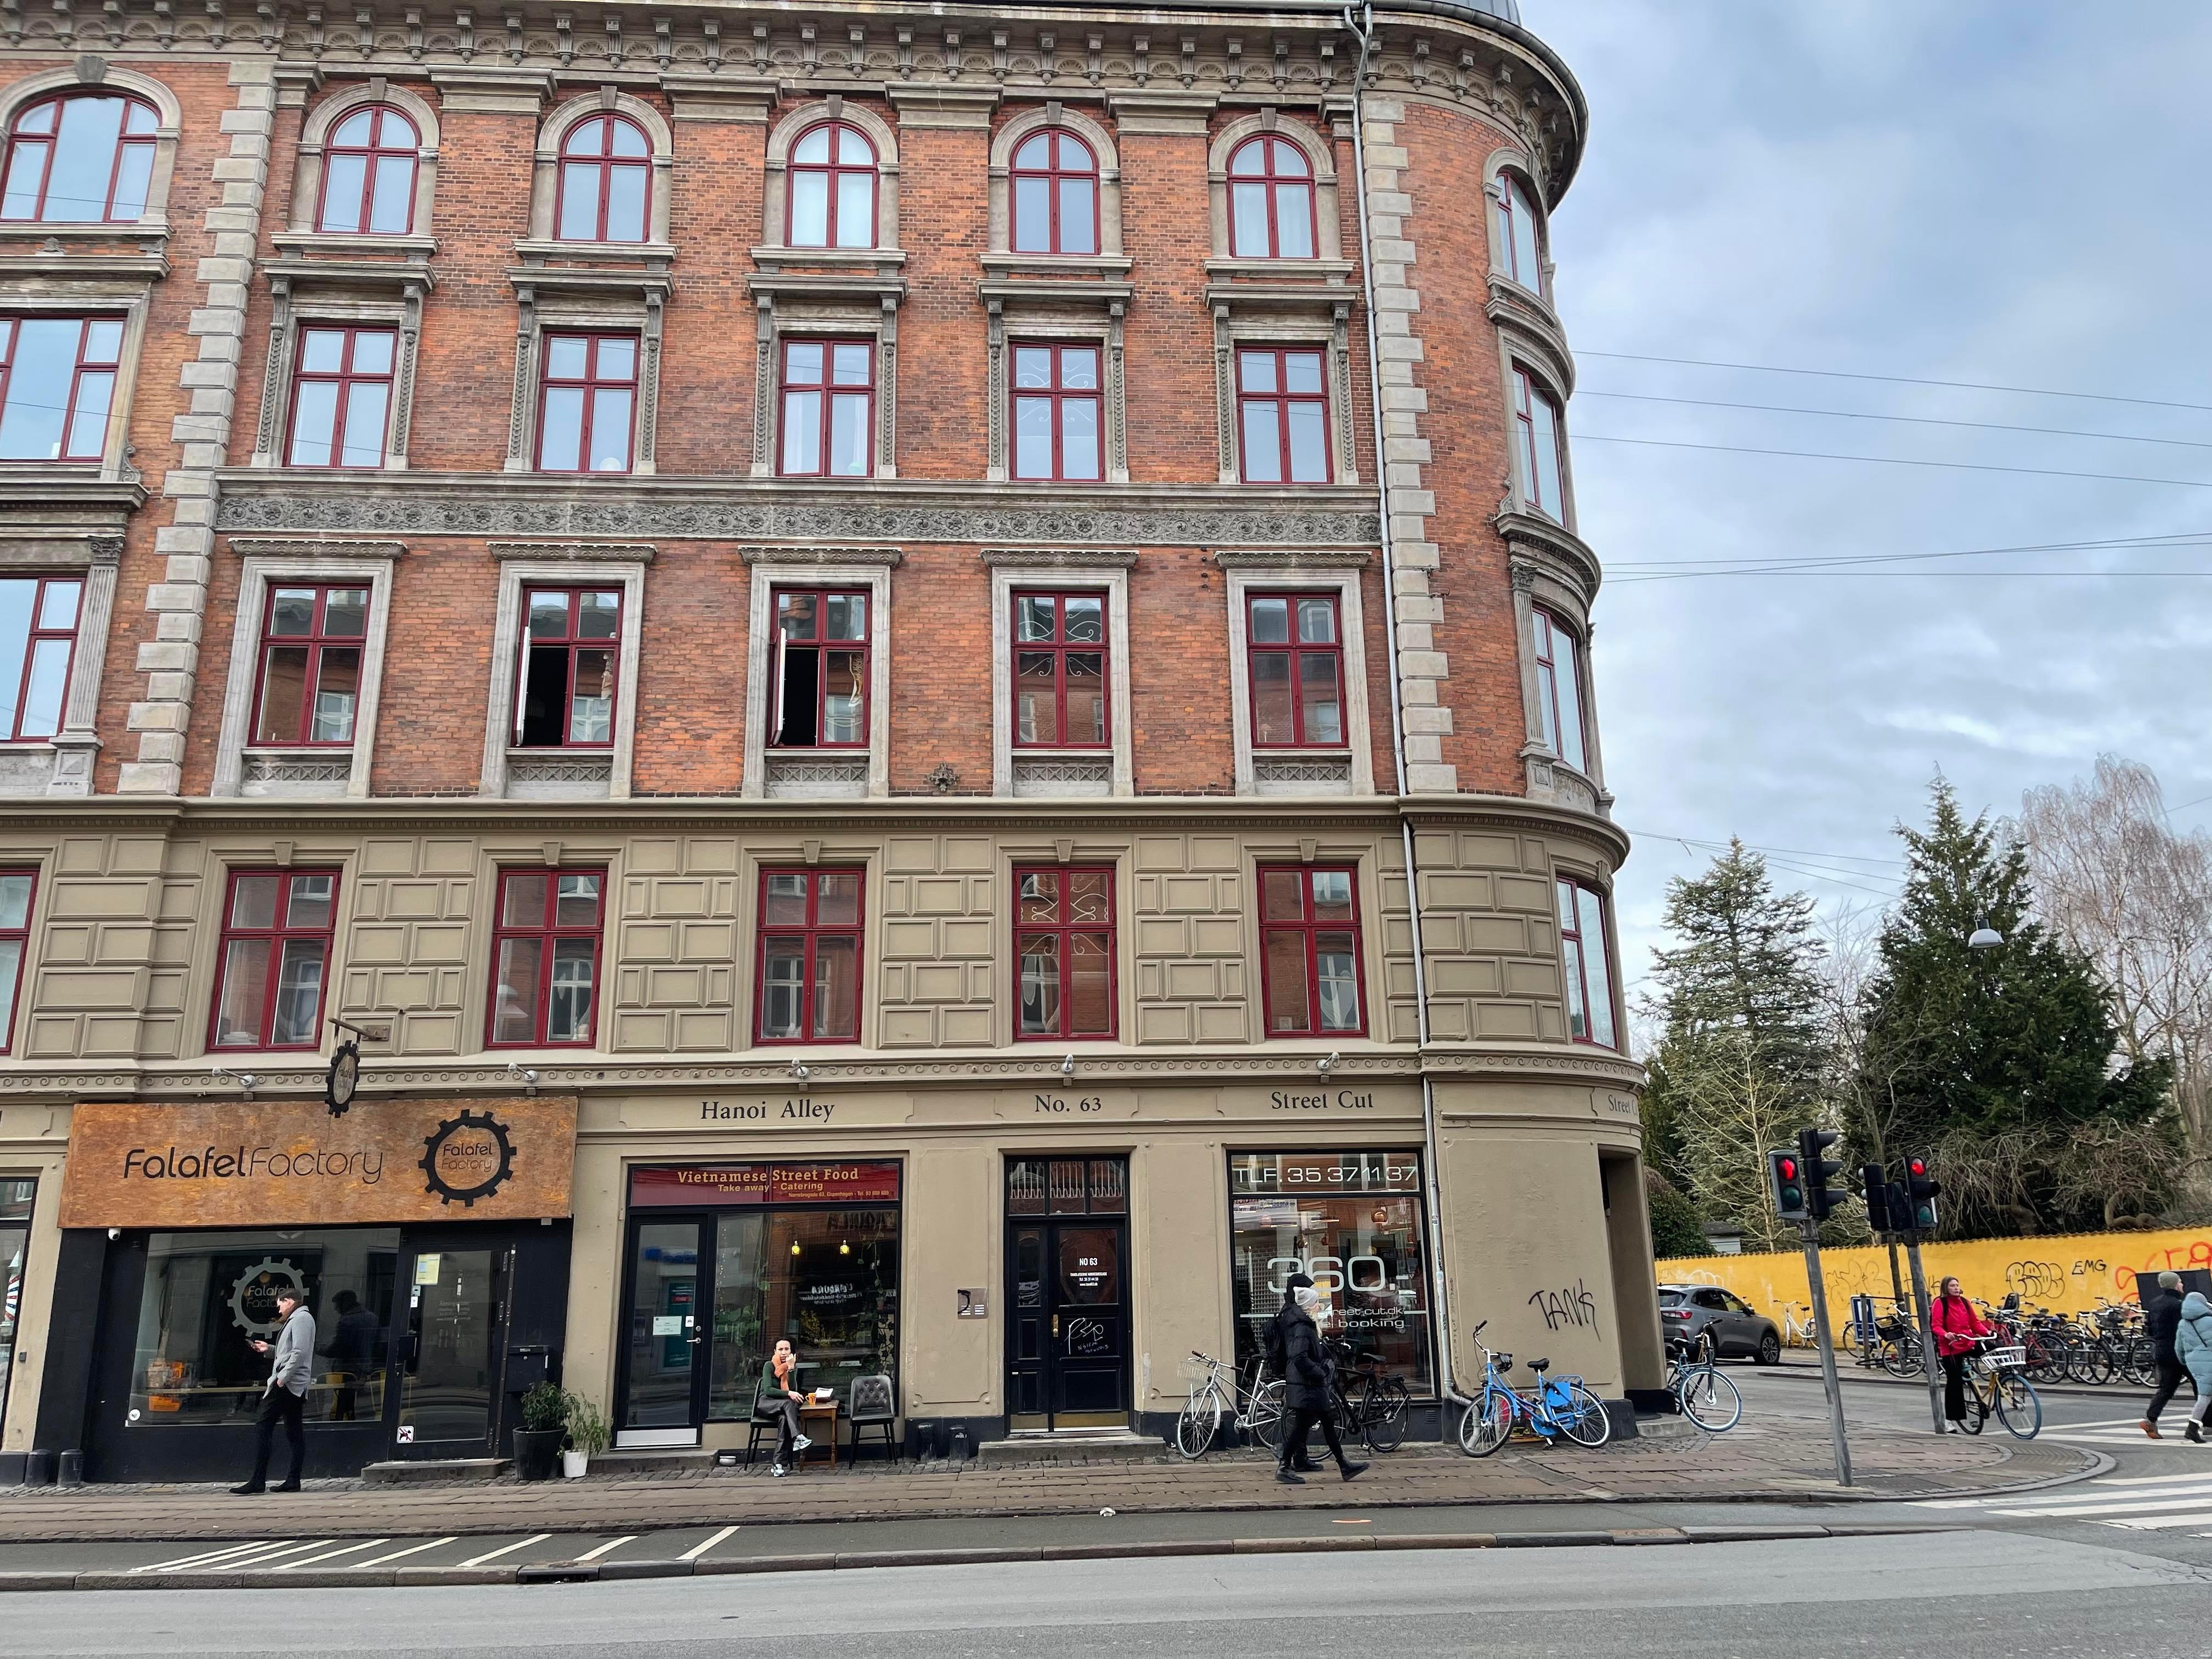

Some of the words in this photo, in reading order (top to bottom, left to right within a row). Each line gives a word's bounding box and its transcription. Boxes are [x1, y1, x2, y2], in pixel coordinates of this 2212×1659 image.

[1035, 1094, 1070, 1112] No.
[1080, 1097, 1102, 1111] 63
[1271, 1091, 1328, 1109] Street
[1338, 1090, 1374, 1108] Cut
[1608, 1094, 1631, 1114] Street
[701, 1101, 767, 1119] Hanoi
[780, 1099, 835, 1123] Alley
[443, 1142, 493, 1156] Falafel
[442, 1158, 492, 1172] Factory
[677, 1170, 768, 1183] Vietnamese
[772, 1168, 818, 1181] Street
[823, 1167, 859, 1180] Food
[1238, 1168, 1283, 1183] TLF.
[1287, 1167, 1321, 1182] 35
[1386, 1166, 1417, 1181] 37
[718, 1184, 741, 1192] Take
[744, 1184, 770, 1193] away
[780, 1182, 823, 1190] Catering
[1079, 1257, 1088, 1266] NO
[1089, 1257, 1098, 1266] 63
[247, 1297, 277, 1308] Facto
[1338, 1318, 1404, 1329] booking
